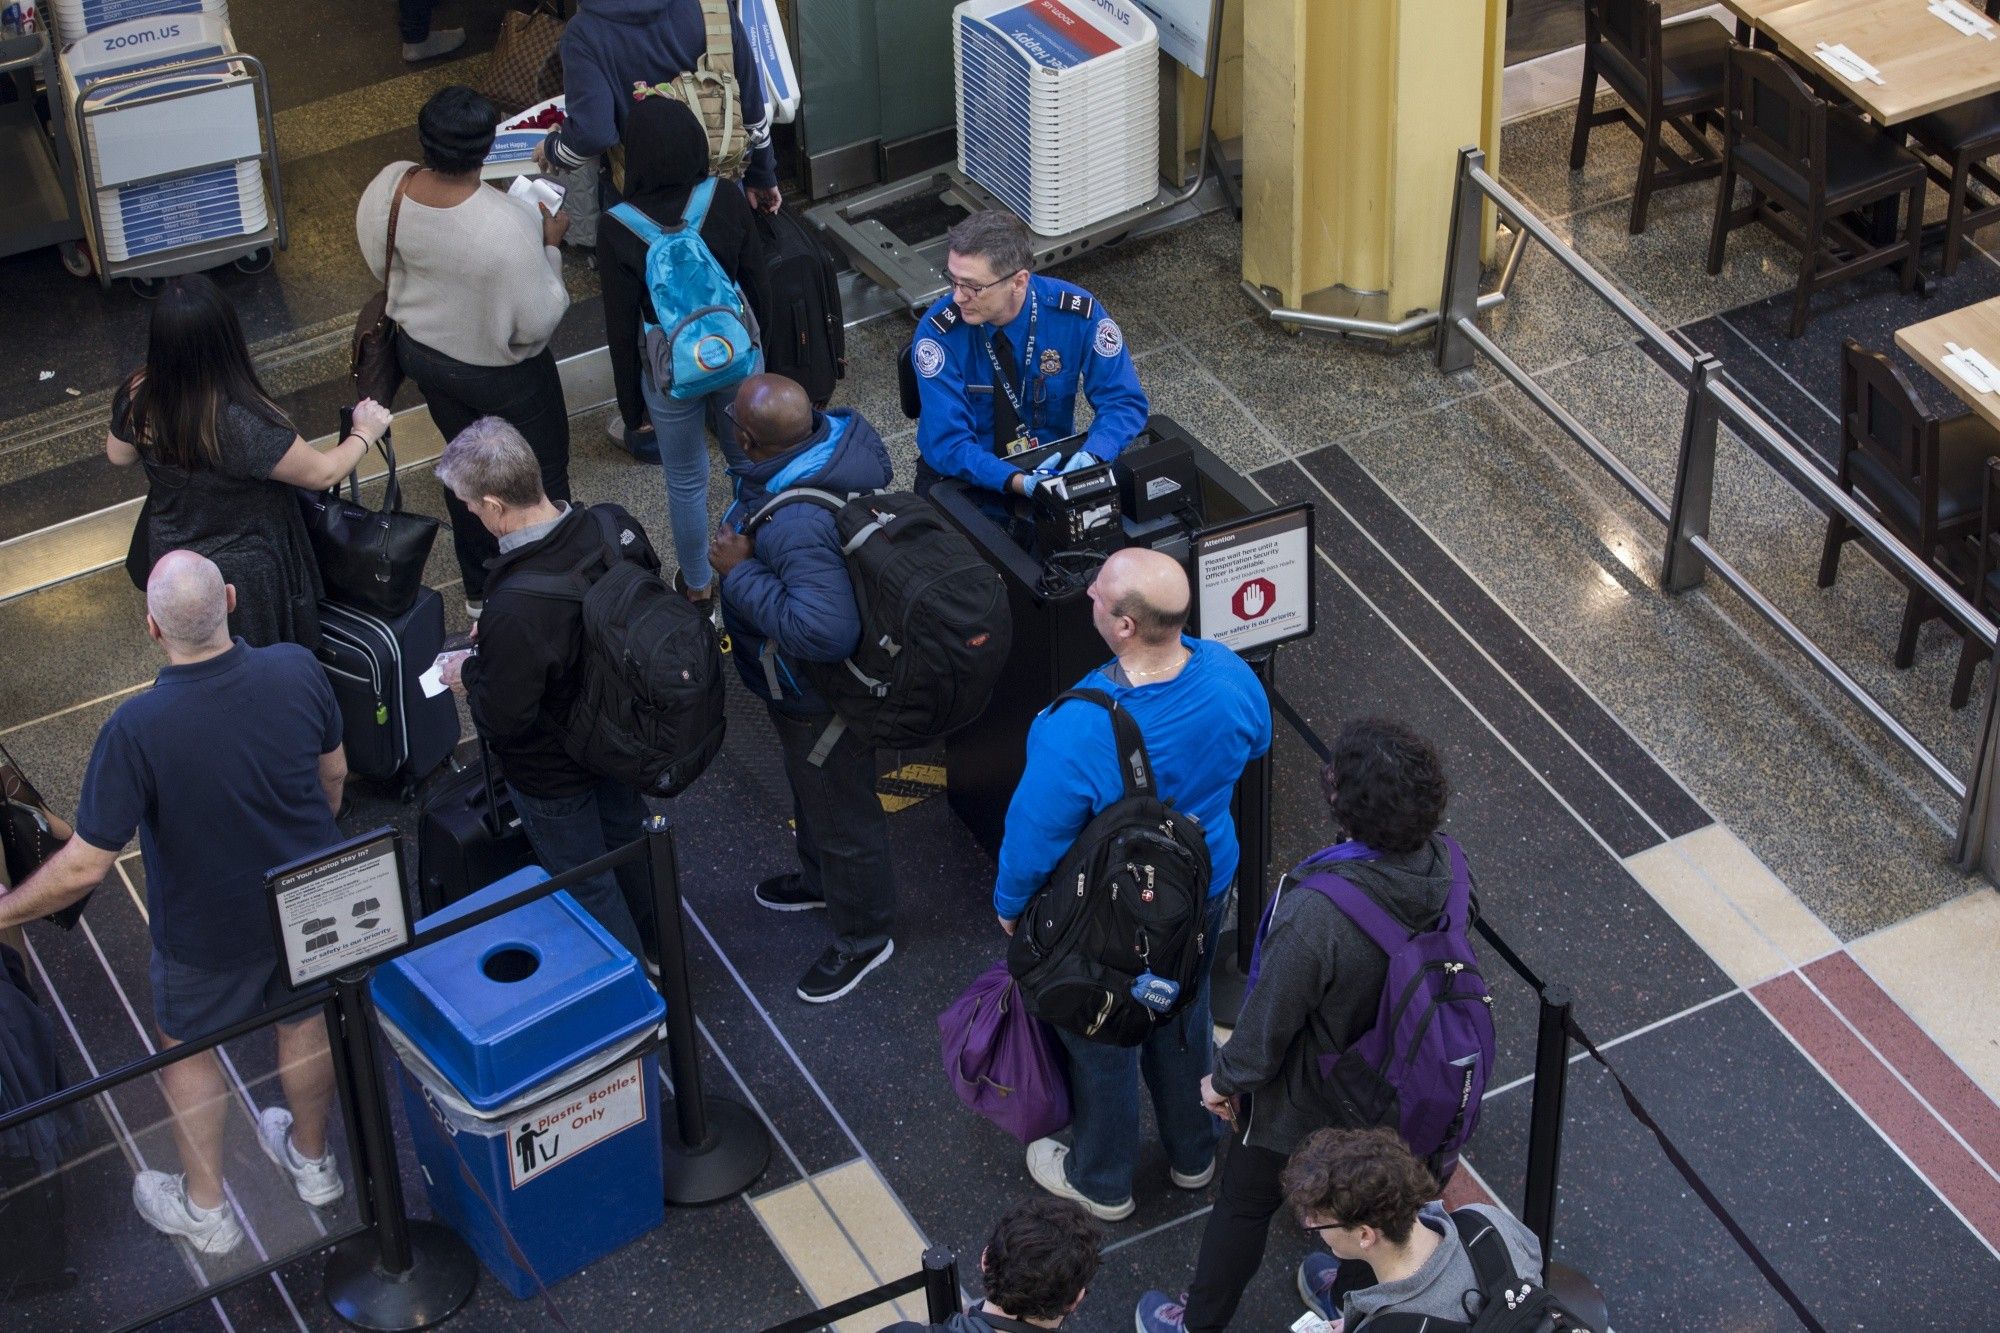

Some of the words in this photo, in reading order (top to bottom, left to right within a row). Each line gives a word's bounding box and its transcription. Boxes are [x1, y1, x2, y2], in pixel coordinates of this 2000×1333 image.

[1041, 1, 1075, 26] zoom.us
[1091, 0, 1130, 25] om.us
[103, 25, 180, 51] zoom.us
[1011, 29, 1051, 60] Happy.
[1046, 57, 1068, 70] eet
[941, 306, 957, 325] TSA
[1070, 295, 1082, 311] TSA
[985, 341, 1002, 371] FLETC
[1025, 335, 1035, 366] FLETC
[1003, 381, 1020, 410] FLETC
[1204, 534, 1236, 548] Attention
[1205, 555, 1226, 567] Please
[1227, 551, 1241, 560] wait
[1242, 547, 1257, 556] here
[1258, 542, 1272, 551] until
[1205, 556, 1252, 574] Transportation
[1253, 548, 1280, 560] Security
[1205, 569, 1228, 581] Officer
[1235, 559, 1265, 573] available.
[1205, 580, 1220, 589] Have
[1231, 574, 1241, 582] and
[1242, 567, 1266, 579] boarding
[1266, 564, 1279, 573] pass
[1213, 630, 1229, 639] Your
[1230, 622, 1251, 634] safety
[1251, 620, 1257, 628] is
[1258, 617, 1270, 626] our
[1271, 610, 1296, 623] priority
[281, 877, 296, 886] Can
[296, 870, 313, 881] Your
[314, 861, 340, 874] Laptop
[340, 853, 357, 864] Stay
[358, 849, 369, 857] In?
[301, 954, 318, 965] Your
[319, 946, 342, 958] safety
[342, 942, 350, 950] is
[350, 937, 363, 947] our
[364, 927, 392, 942] priority
[1144, 991, 1171, 1007] reuse
[538, 1102, 583, 1132] Plastic
[588, 1075, 637, 1105] Bottles
[571, 1107, 605, 1131] Only
